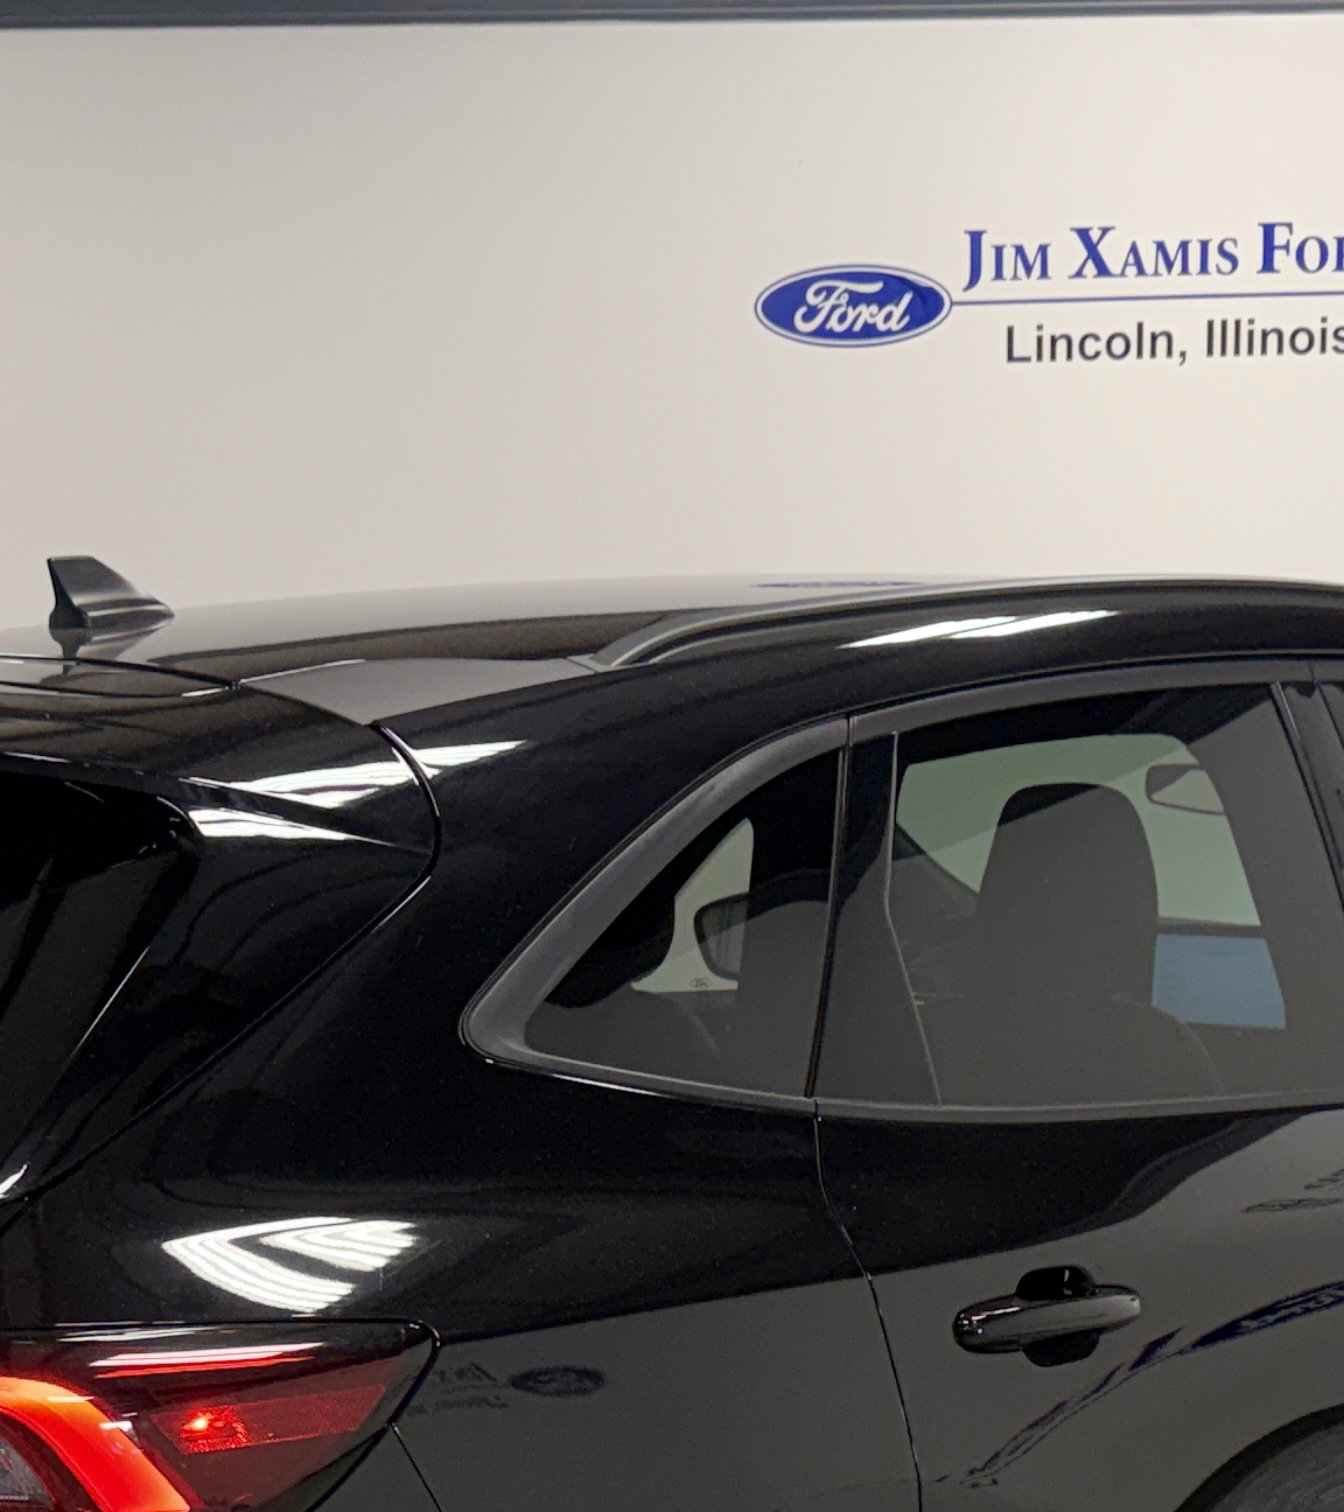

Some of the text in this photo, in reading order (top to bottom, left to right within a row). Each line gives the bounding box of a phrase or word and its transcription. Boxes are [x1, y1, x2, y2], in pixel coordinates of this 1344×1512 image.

[962, 229, 1052, 292] JIM
[1068, 226, 1239, 280] XAMIS
[794, 279, 911, 334] Ford
[1006, 321, 1187, 366] Lincoln,
